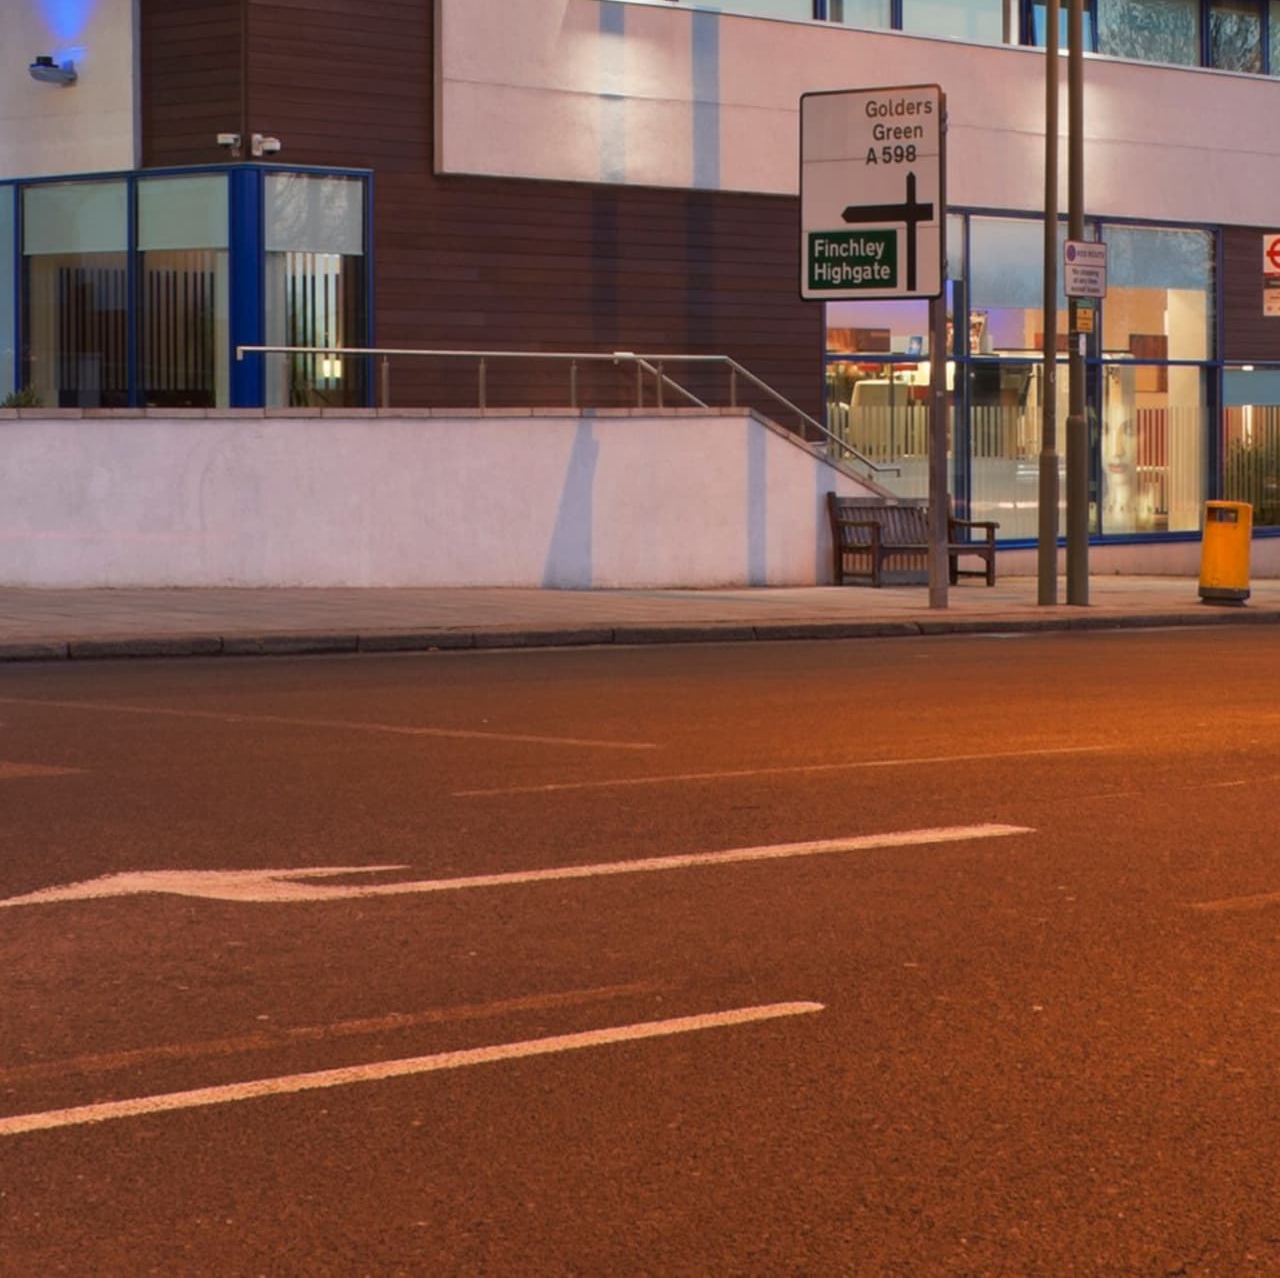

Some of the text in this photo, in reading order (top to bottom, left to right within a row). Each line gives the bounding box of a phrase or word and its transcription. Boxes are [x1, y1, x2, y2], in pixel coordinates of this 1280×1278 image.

[865, 98, 933, 118] Golders
[873, 123, 923, 141] Green
[814, 238, 885, 259] Finchley
[814, 262, 891, 284] Highgate
